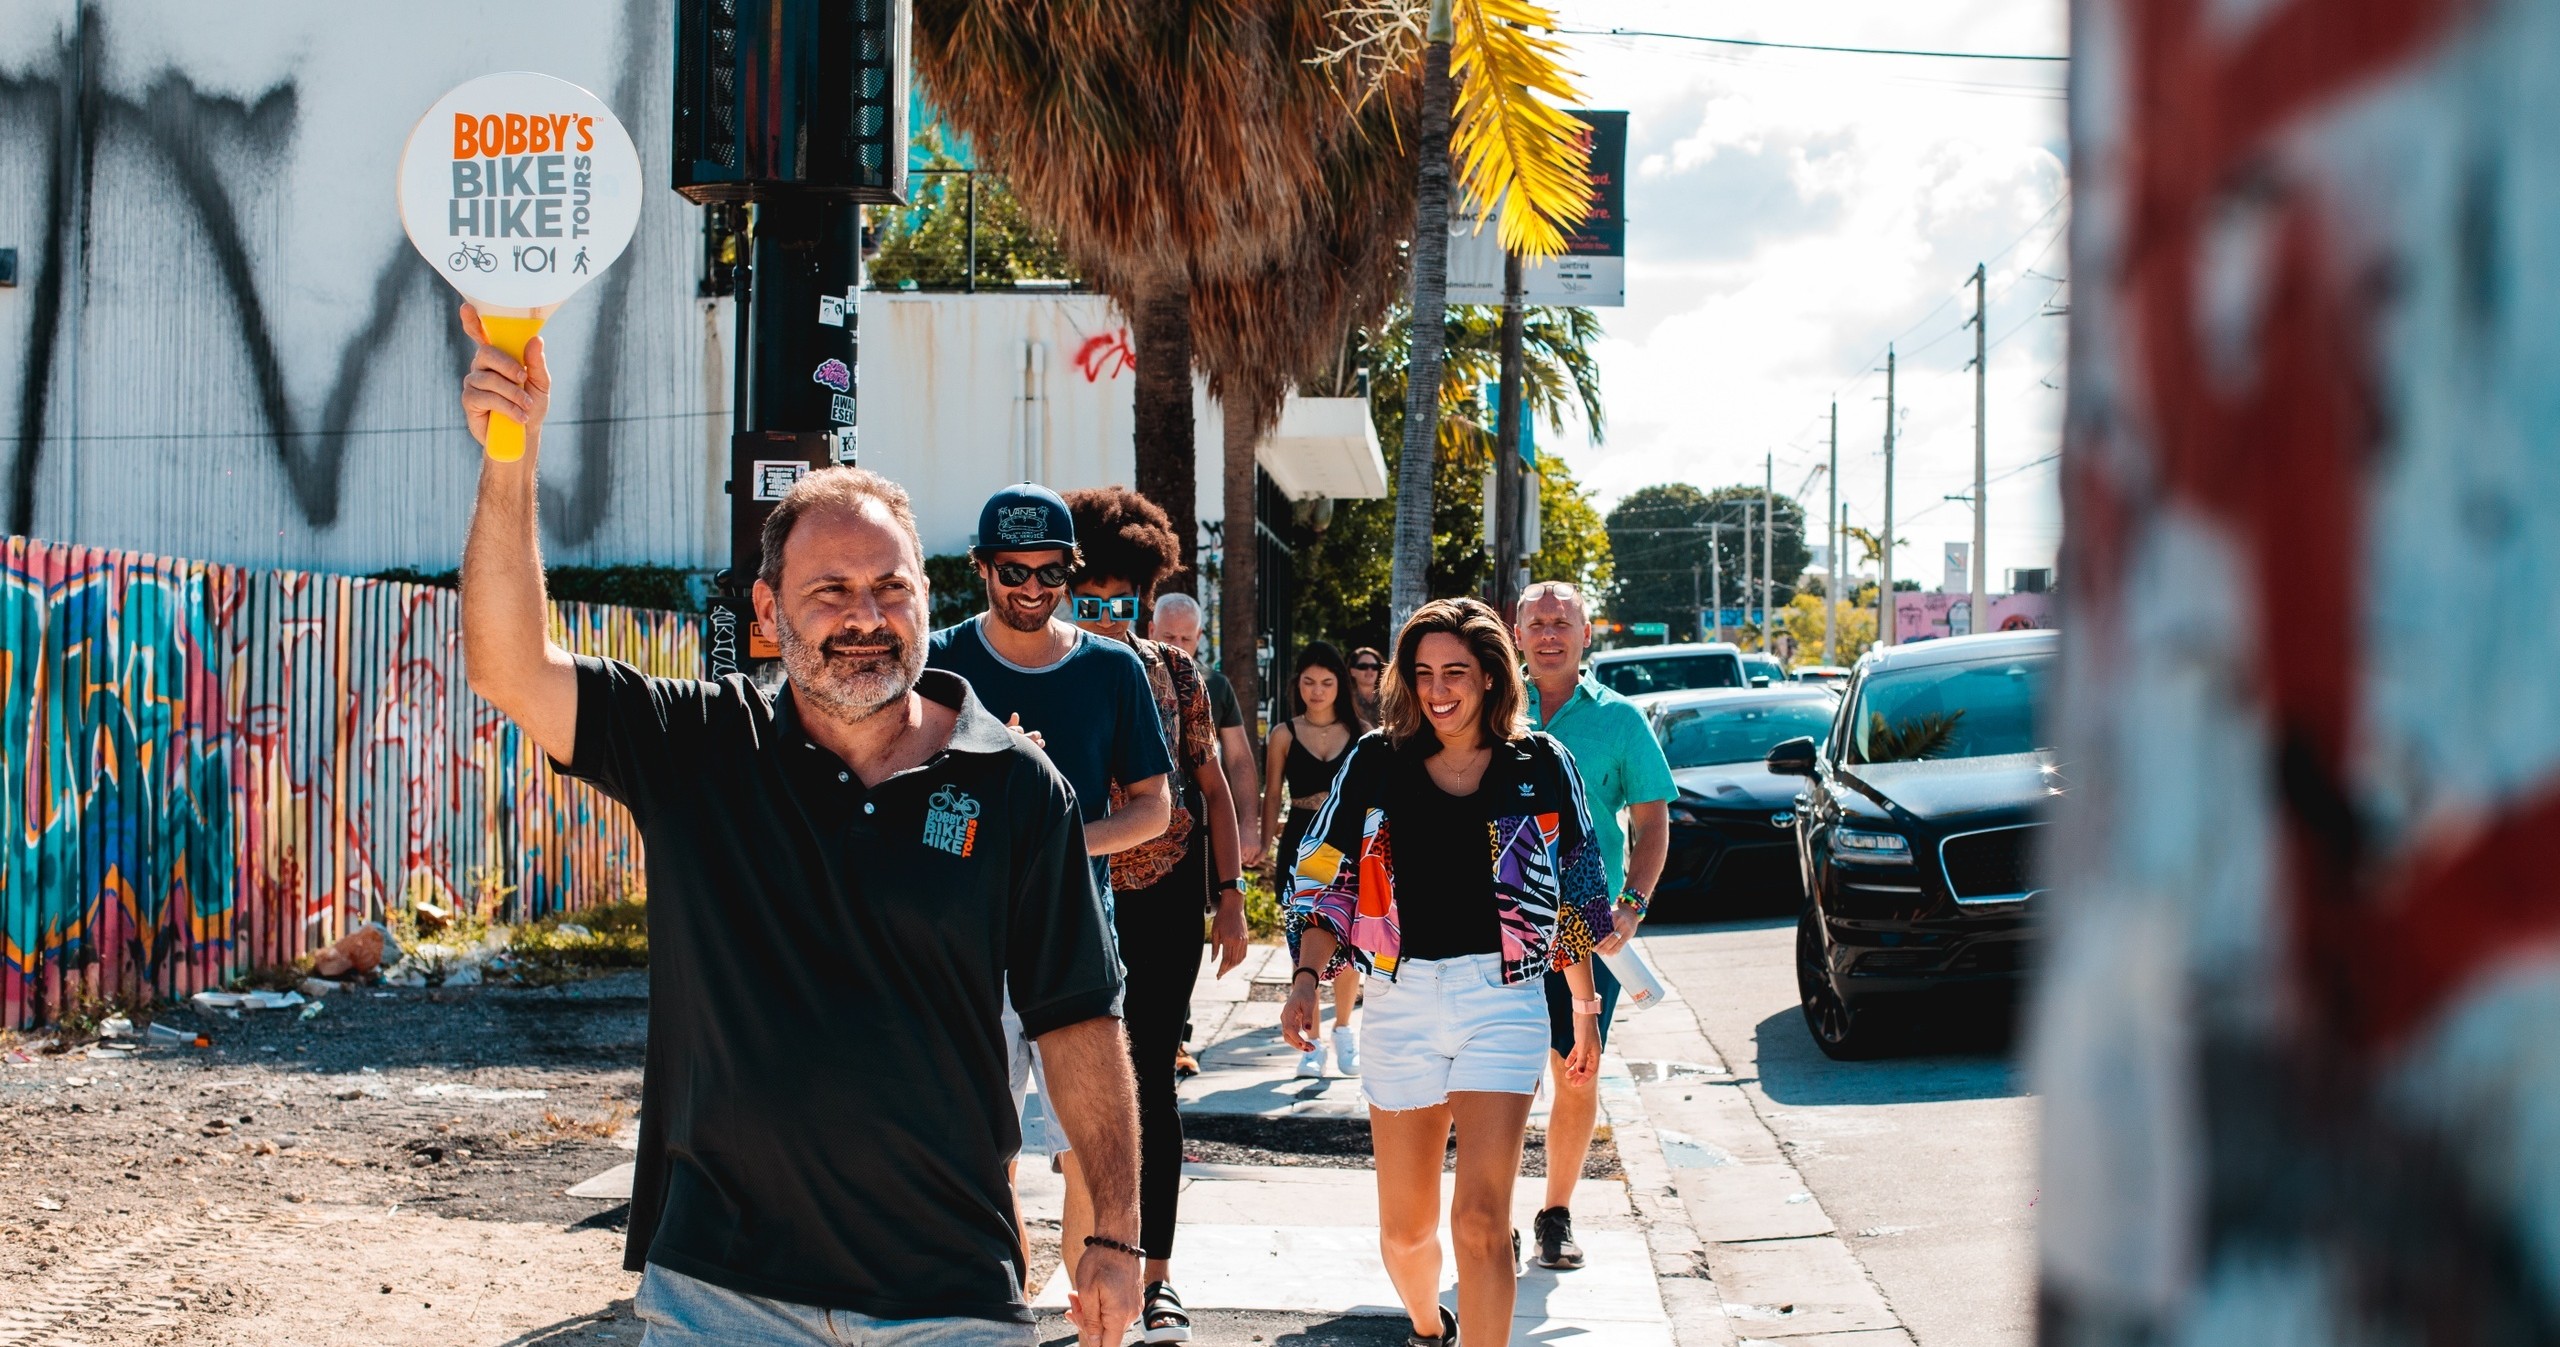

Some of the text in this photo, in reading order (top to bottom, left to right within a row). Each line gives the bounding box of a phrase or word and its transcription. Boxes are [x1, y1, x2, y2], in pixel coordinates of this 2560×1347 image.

[454, 113, 594, 160] BOBBY'S
[452, 155, 567, 199] BIKE
[572, 155, 592, 240] TOURS
[449, 199, 564, 238] HIKE
[1008, 507, 1037, 517] VANS
[924, 821, 967, 842] BIKE
[926, 808, 968, 828] BOBBY'S
[922, 831, 964, 856] HIKE
[962, 818, 978, 858] TOURS
